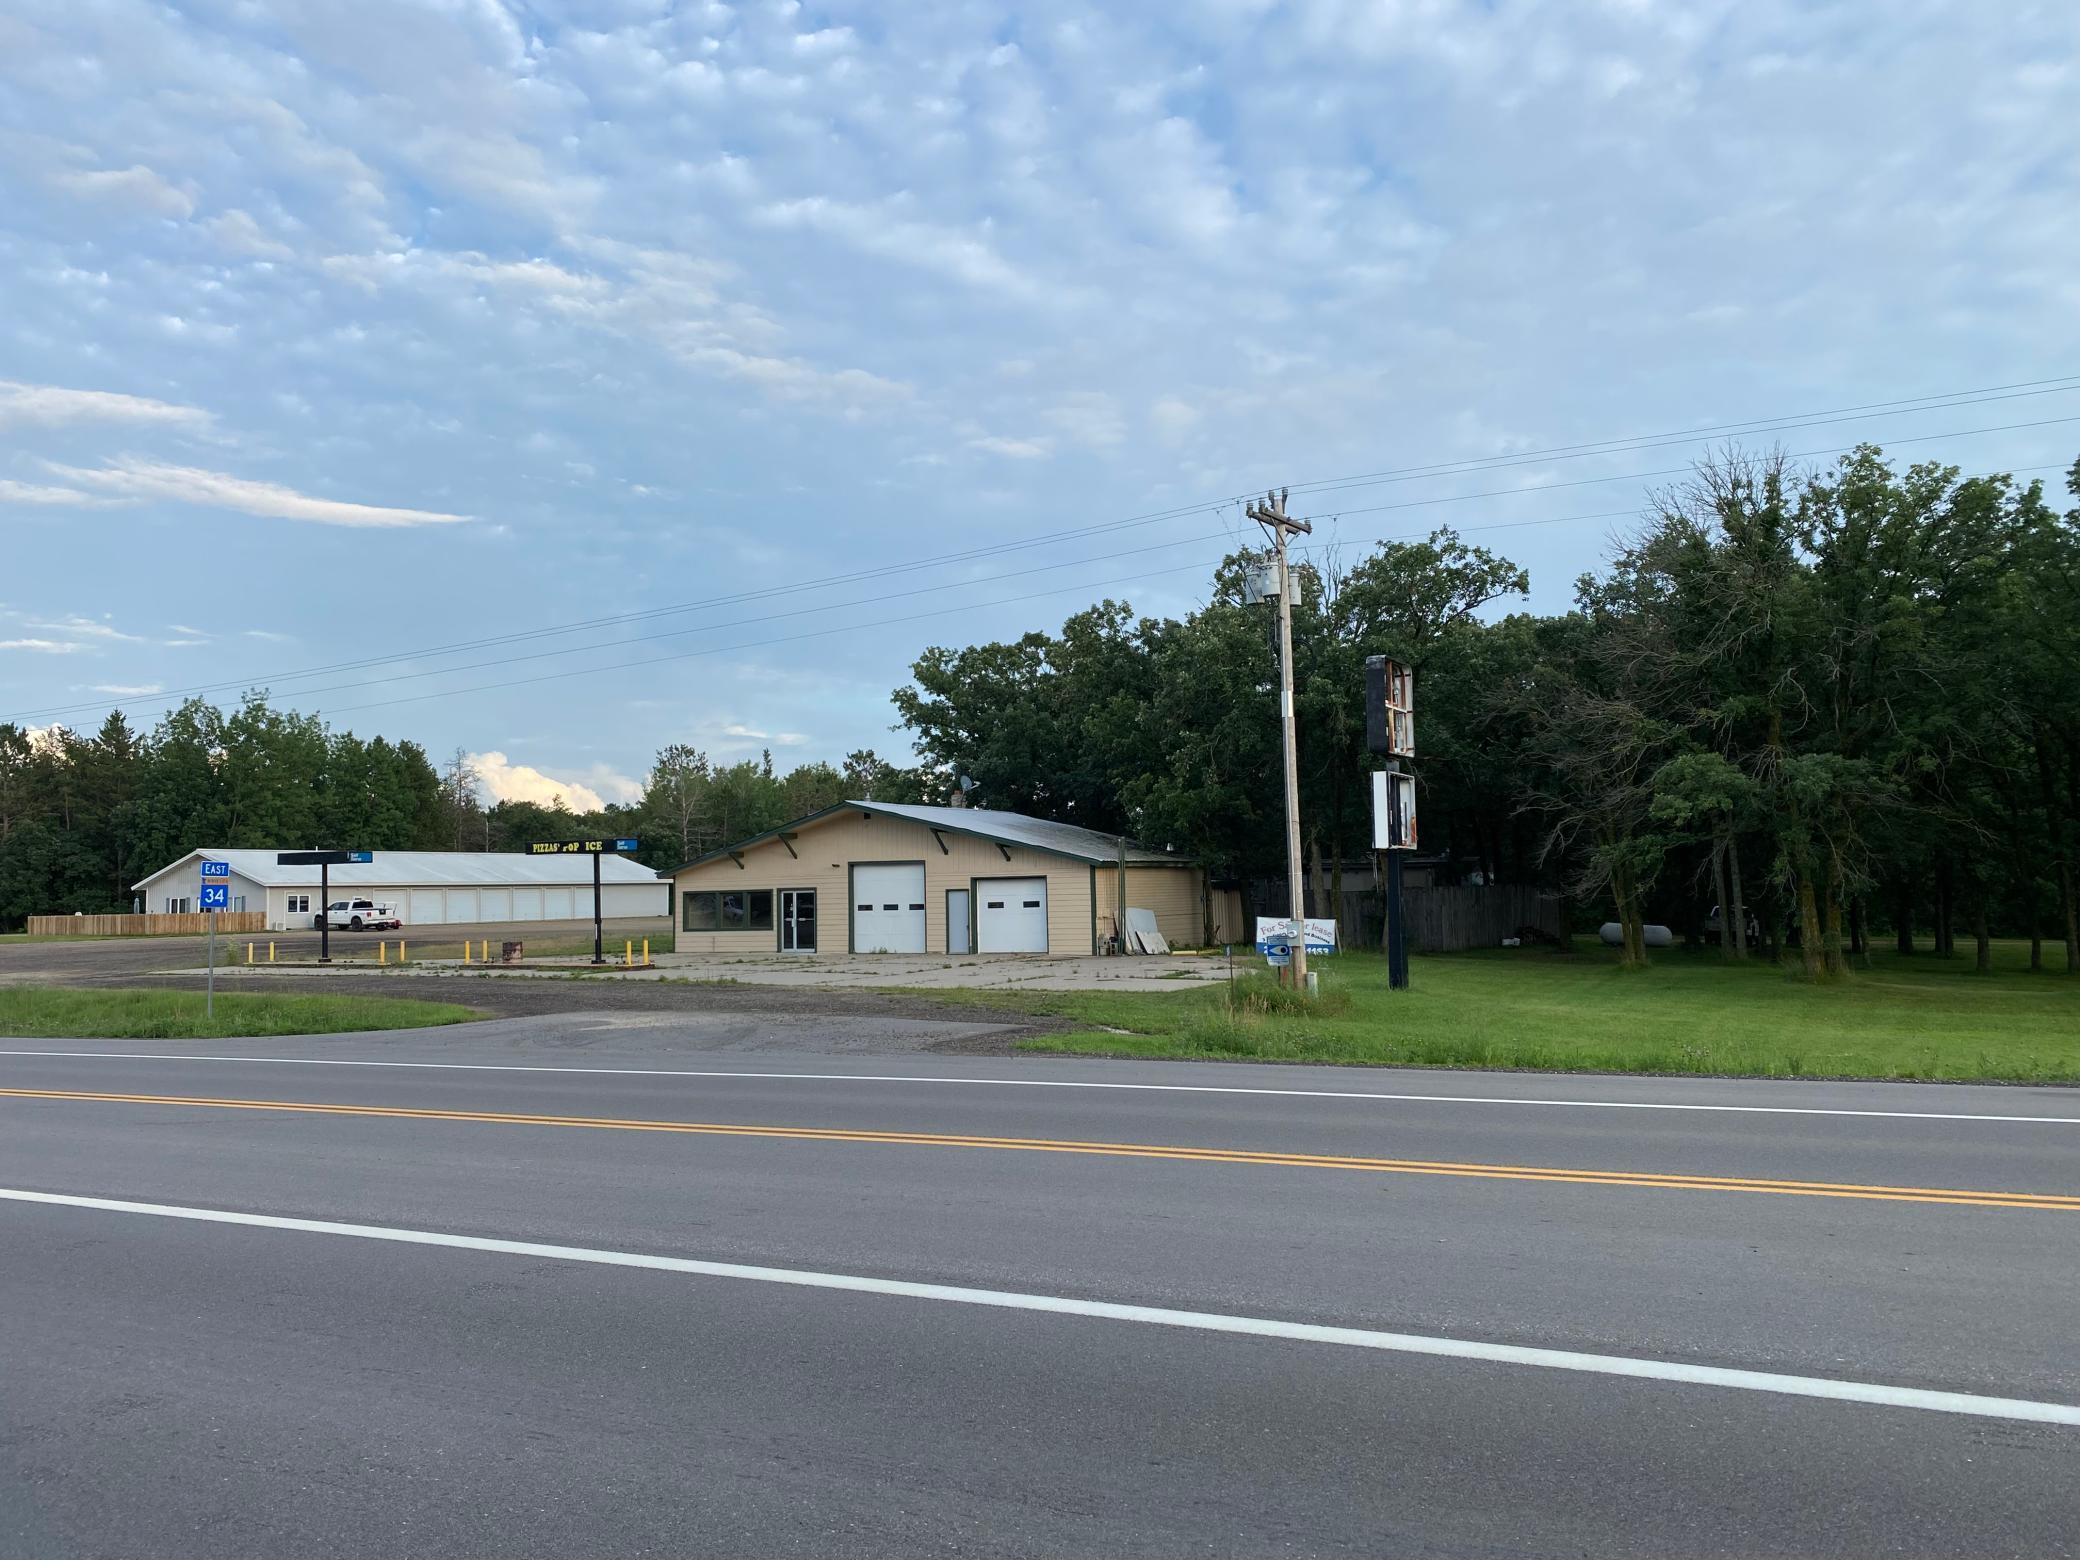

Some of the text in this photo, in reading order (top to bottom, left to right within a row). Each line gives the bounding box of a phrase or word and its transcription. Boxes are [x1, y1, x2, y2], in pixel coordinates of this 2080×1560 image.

[585, 841, 603, 851] ICE
[205, 863, 226, 875] EAST
[205, 888, 225, 903] 34
[1260, 925, 1276, 935] For
[1311, 922, 1333, 938] lease
